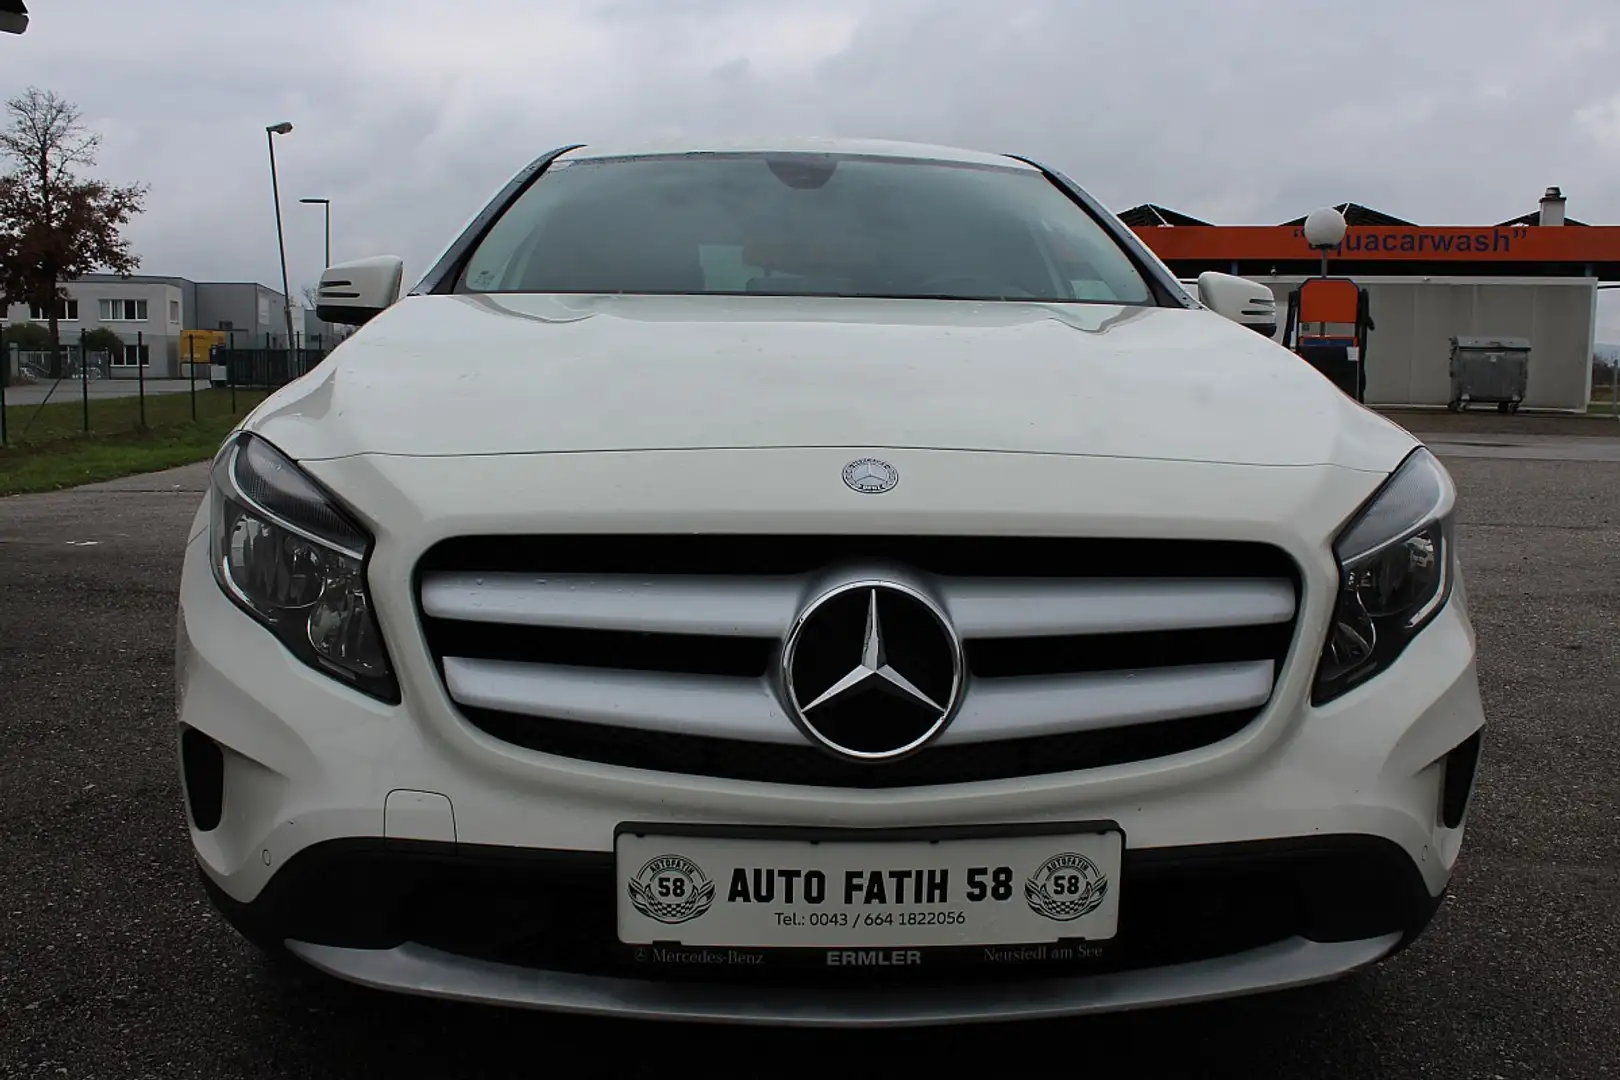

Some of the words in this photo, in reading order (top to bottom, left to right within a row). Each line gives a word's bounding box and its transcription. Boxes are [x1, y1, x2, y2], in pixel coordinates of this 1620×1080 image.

[649, 859, 695, 875] AUTOFATIH
[1046, 855, 1089, 873] AUTOFATIH
[658, 877, 685, 897] 58
[728, 868, 826, 904] AUTO
[844, 869, 949, 904] FATIH
[966, 866, 1013, 902] 58
[1053, 875, 1080, 895] 58
[774, 912, 805, 926] Tel.:
[809, 913, 848, 926] 0043
[852, 913, 860, 928] /
[864, 912, 894, 926] 664
[899, 911, 966, 926] 1822056
[652, 948, 764, 964] Mercedes-Benz
[827, 951, 921, 966] ERMLER
[1051, 948, 1073, 960] am
[1078, 944, 1103, 958] See
